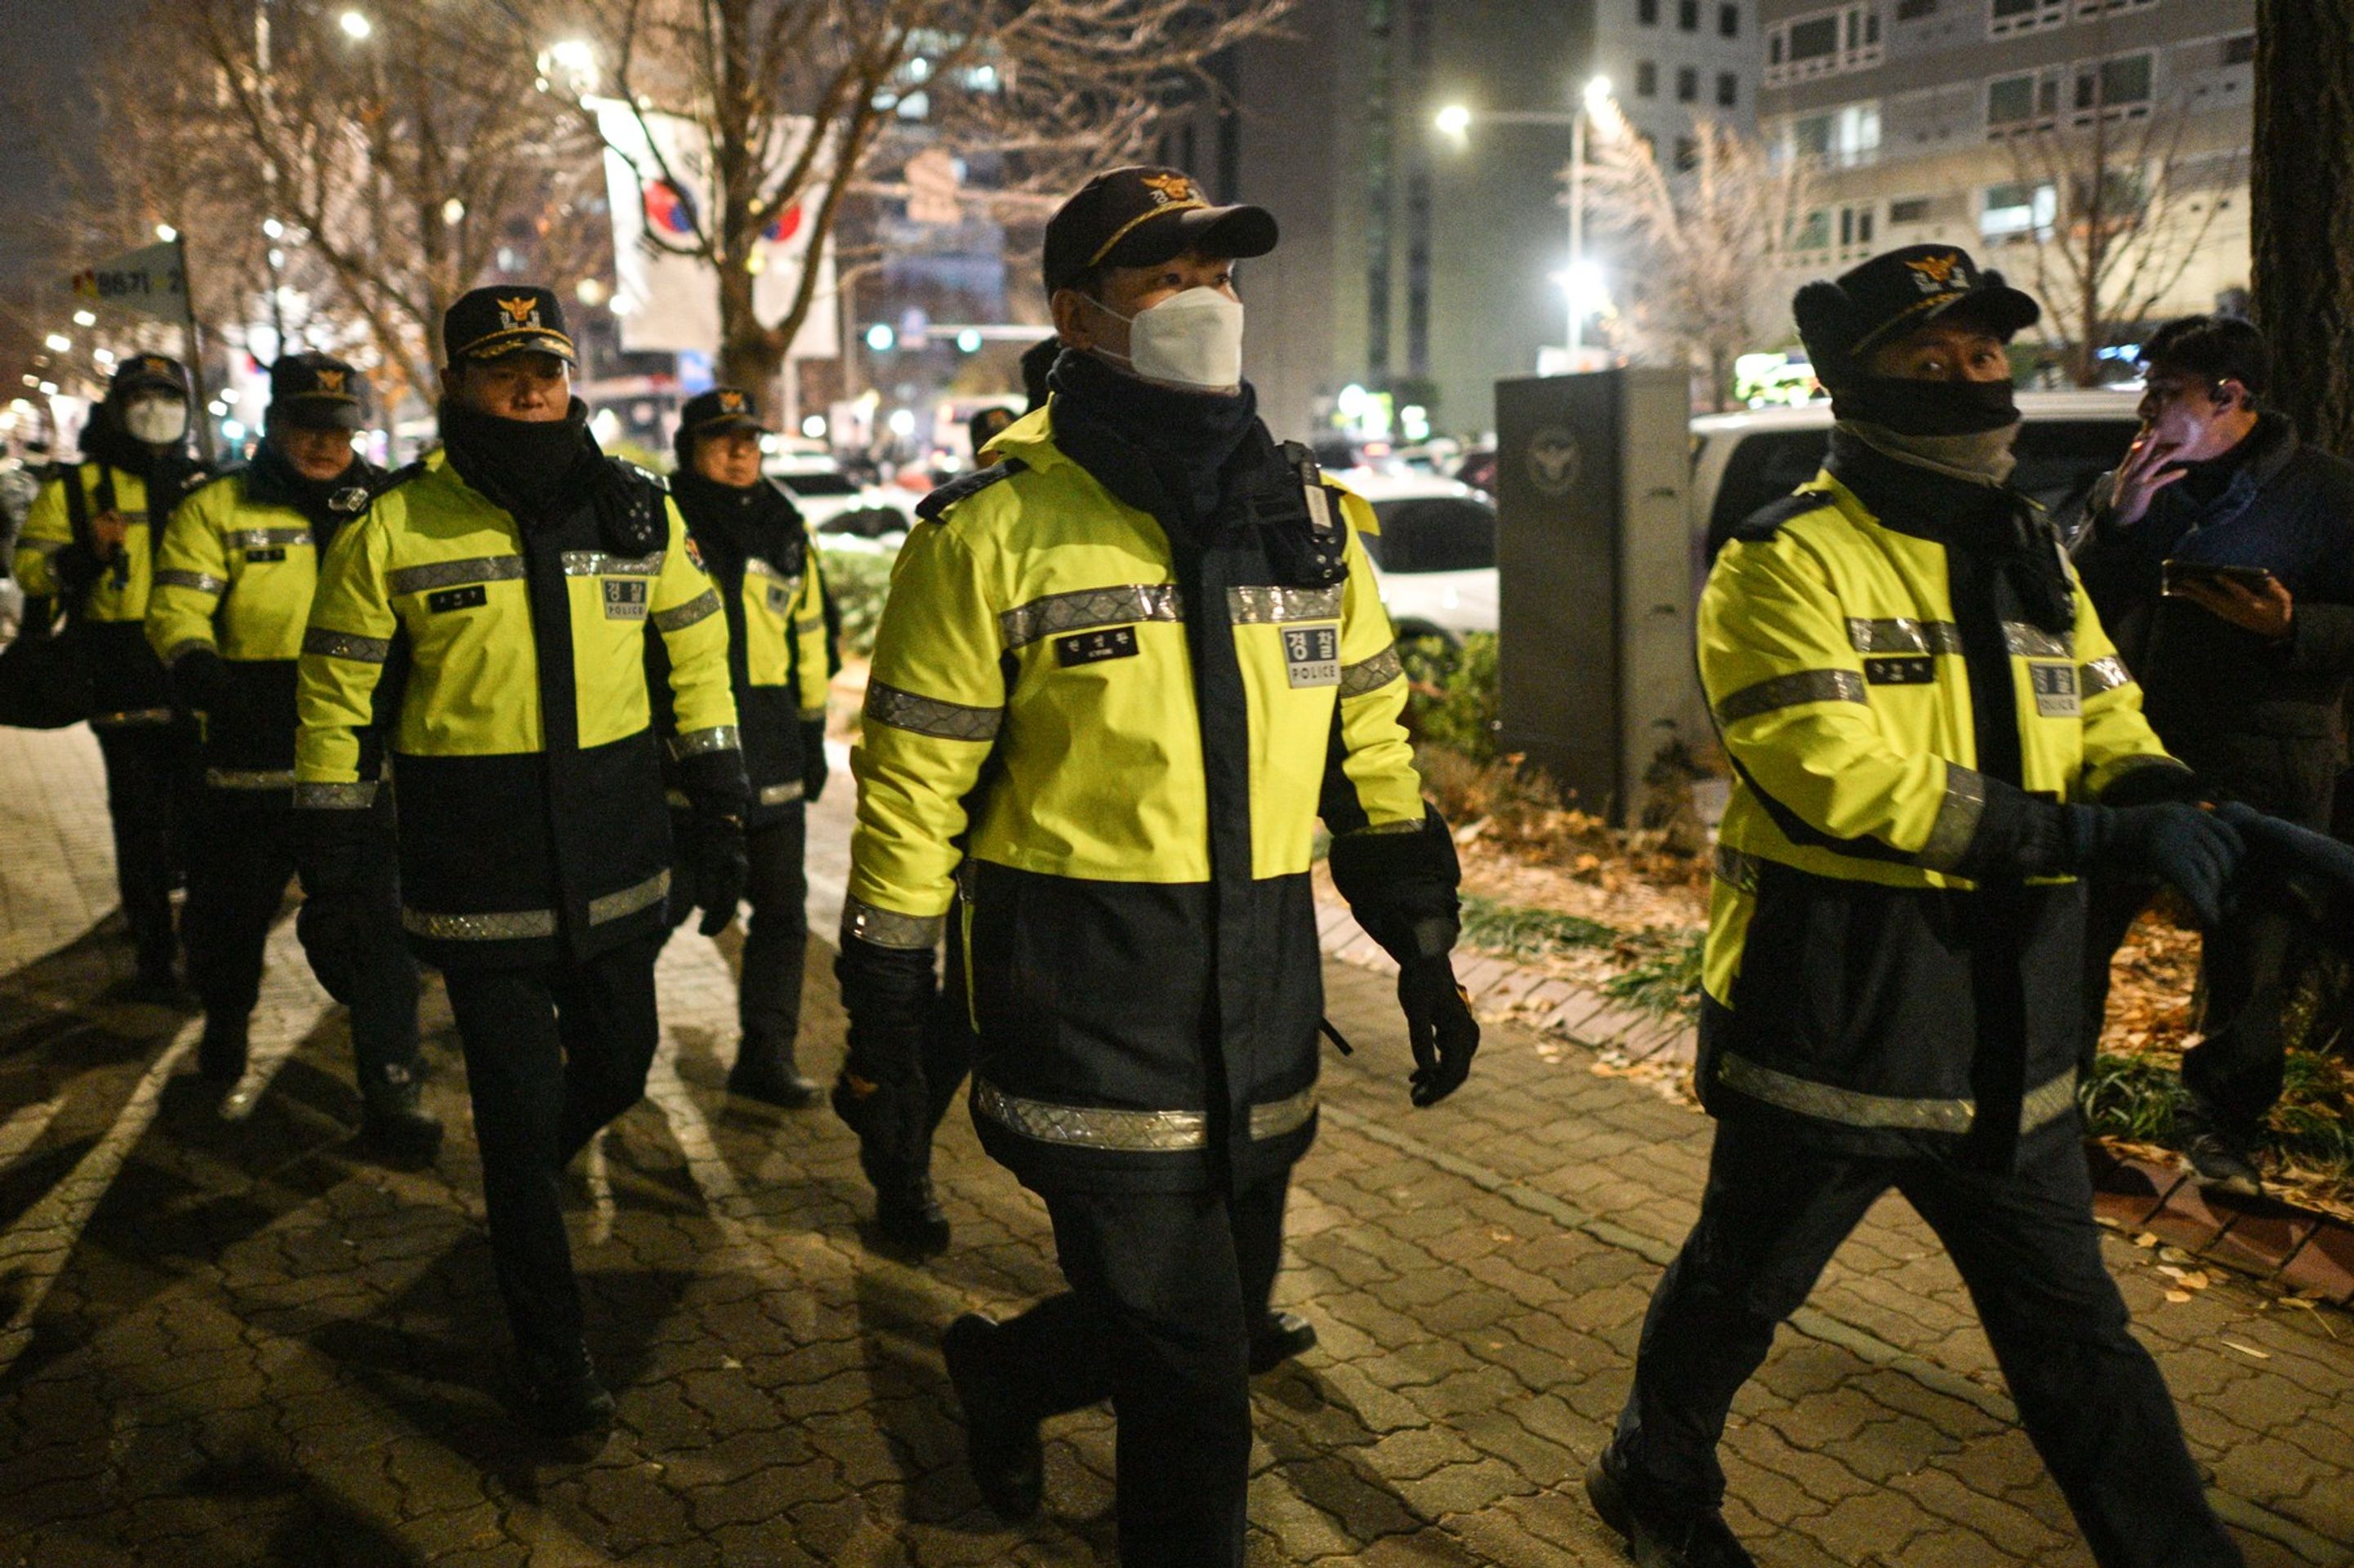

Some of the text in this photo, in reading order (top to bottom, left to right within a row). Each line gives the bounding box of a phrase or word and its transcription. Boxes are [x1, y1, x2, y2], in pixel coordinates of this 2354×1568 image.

[606, 581, 644, 602] 경찰
[608, 604, 644, 616] POLICE
[1287, 631, 1333, 661] 경찰
[1292, 665, 1335, 679] POLICE
